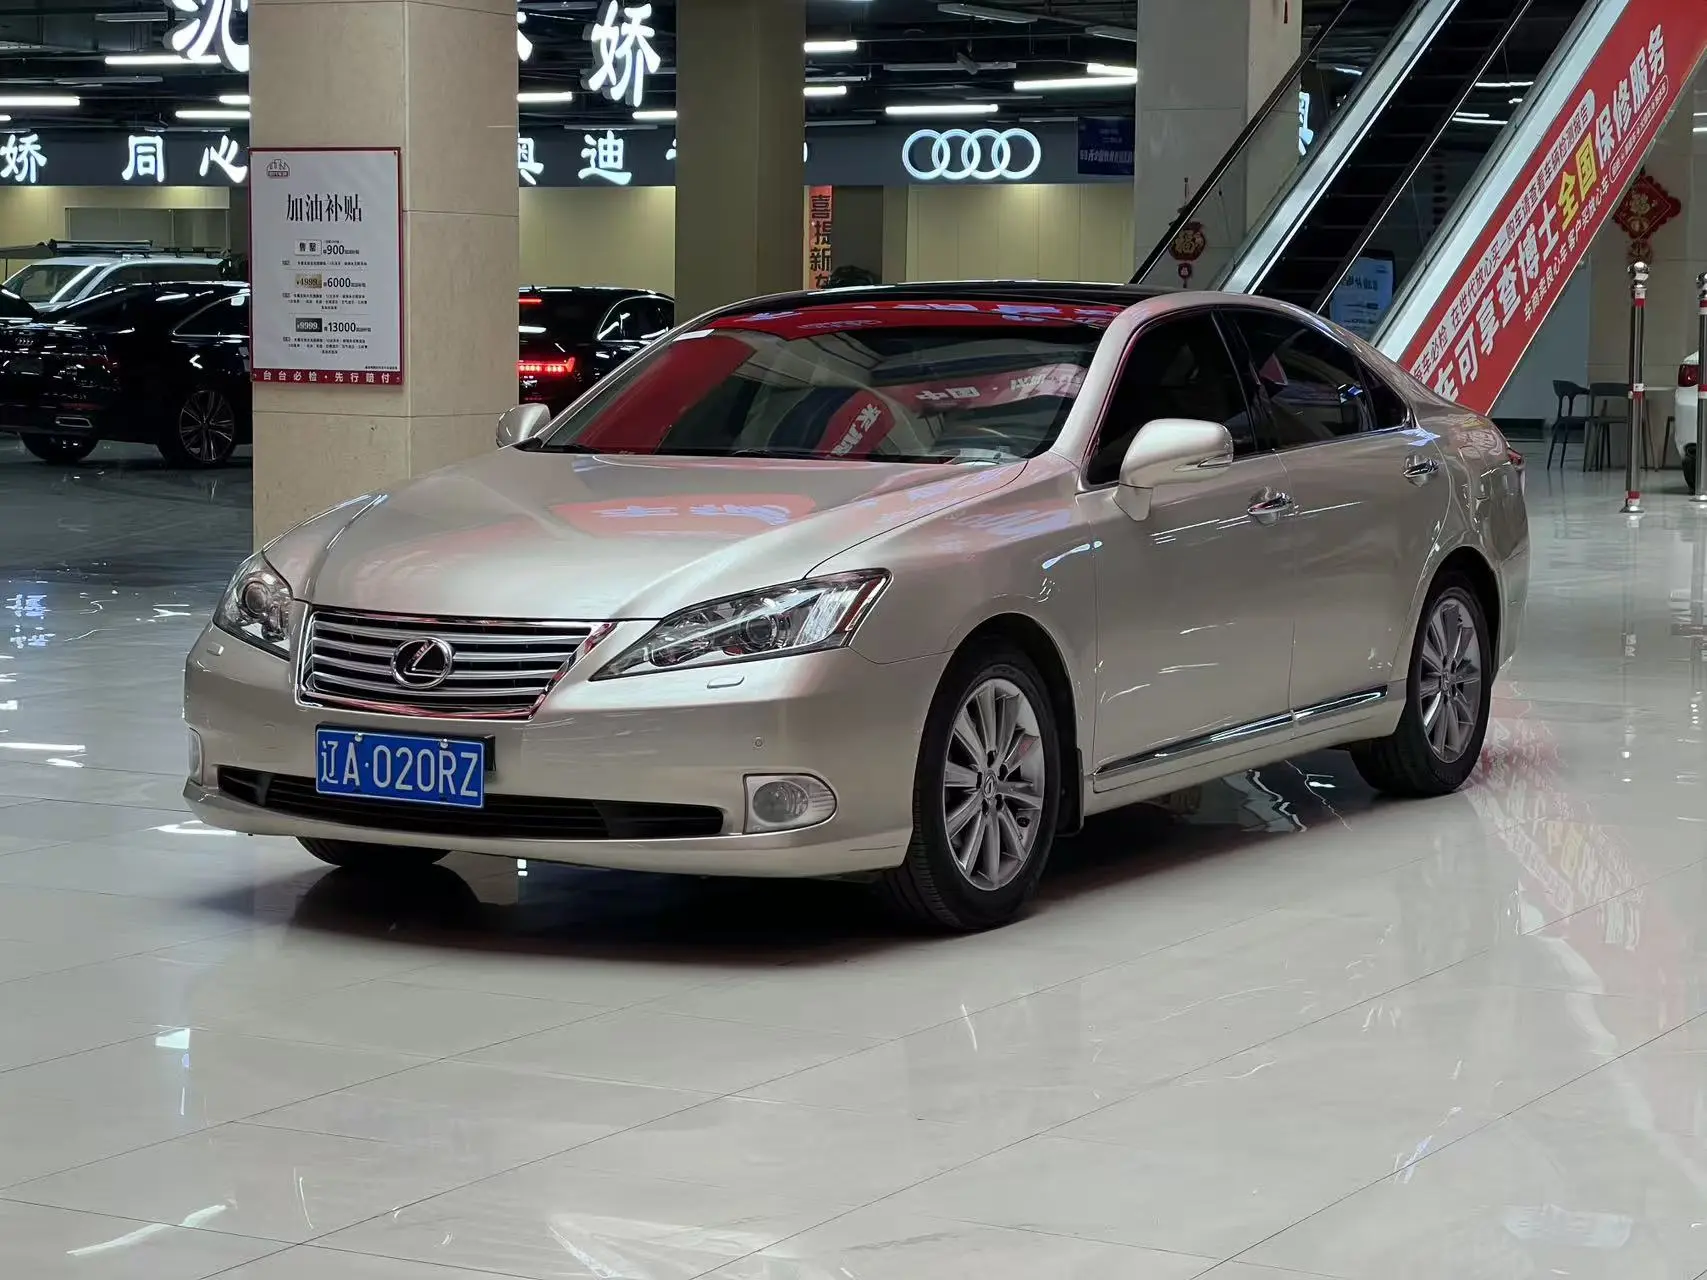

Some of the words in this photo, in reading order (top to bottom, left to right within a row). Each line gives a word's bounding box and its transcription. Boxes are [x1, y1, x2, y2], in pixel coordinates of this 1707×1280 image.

[588, 0, 661, 108] 娇
[286, 193, 362, 222] 加油补贴
